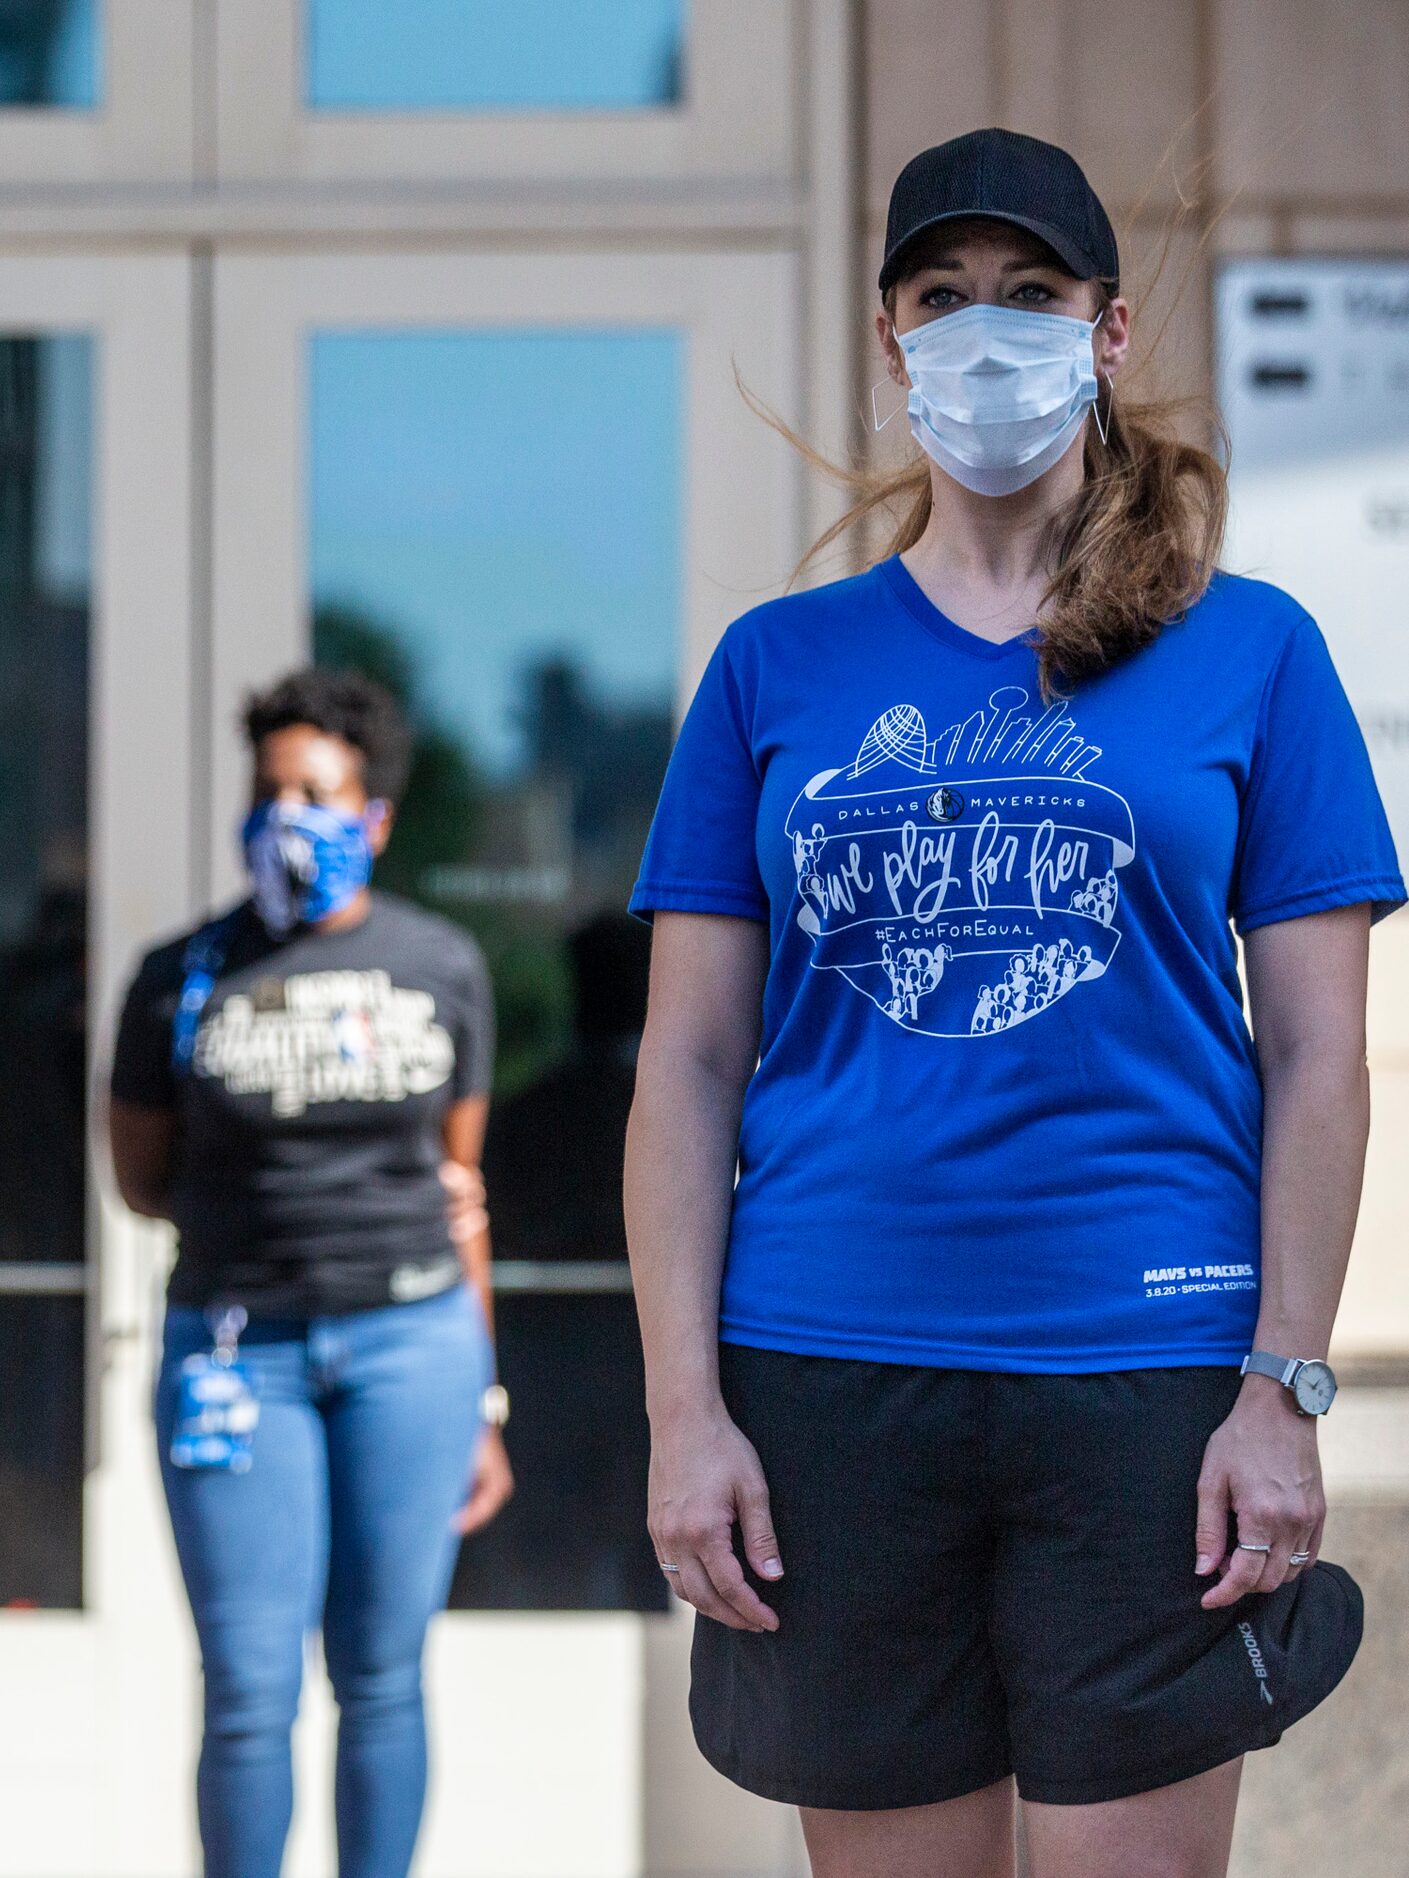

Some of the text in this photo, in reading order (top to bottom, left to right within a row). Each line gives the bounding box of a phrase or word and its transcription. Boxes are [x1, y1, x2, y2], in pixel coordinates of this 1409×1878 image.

[838, 795, 1086, 821] DALLAS MAVERICKS
[827, 811, 1089, 924] we play for her
[1143, 1267, 1186, 1283] MAVS
[1205, 1264, 1253, 1278] PACERS
[1145, 1281, 1257, 1298] 3.8.20 SPECIAL EDITION
[1238, 1622, 1269, 1678] BROOKS
